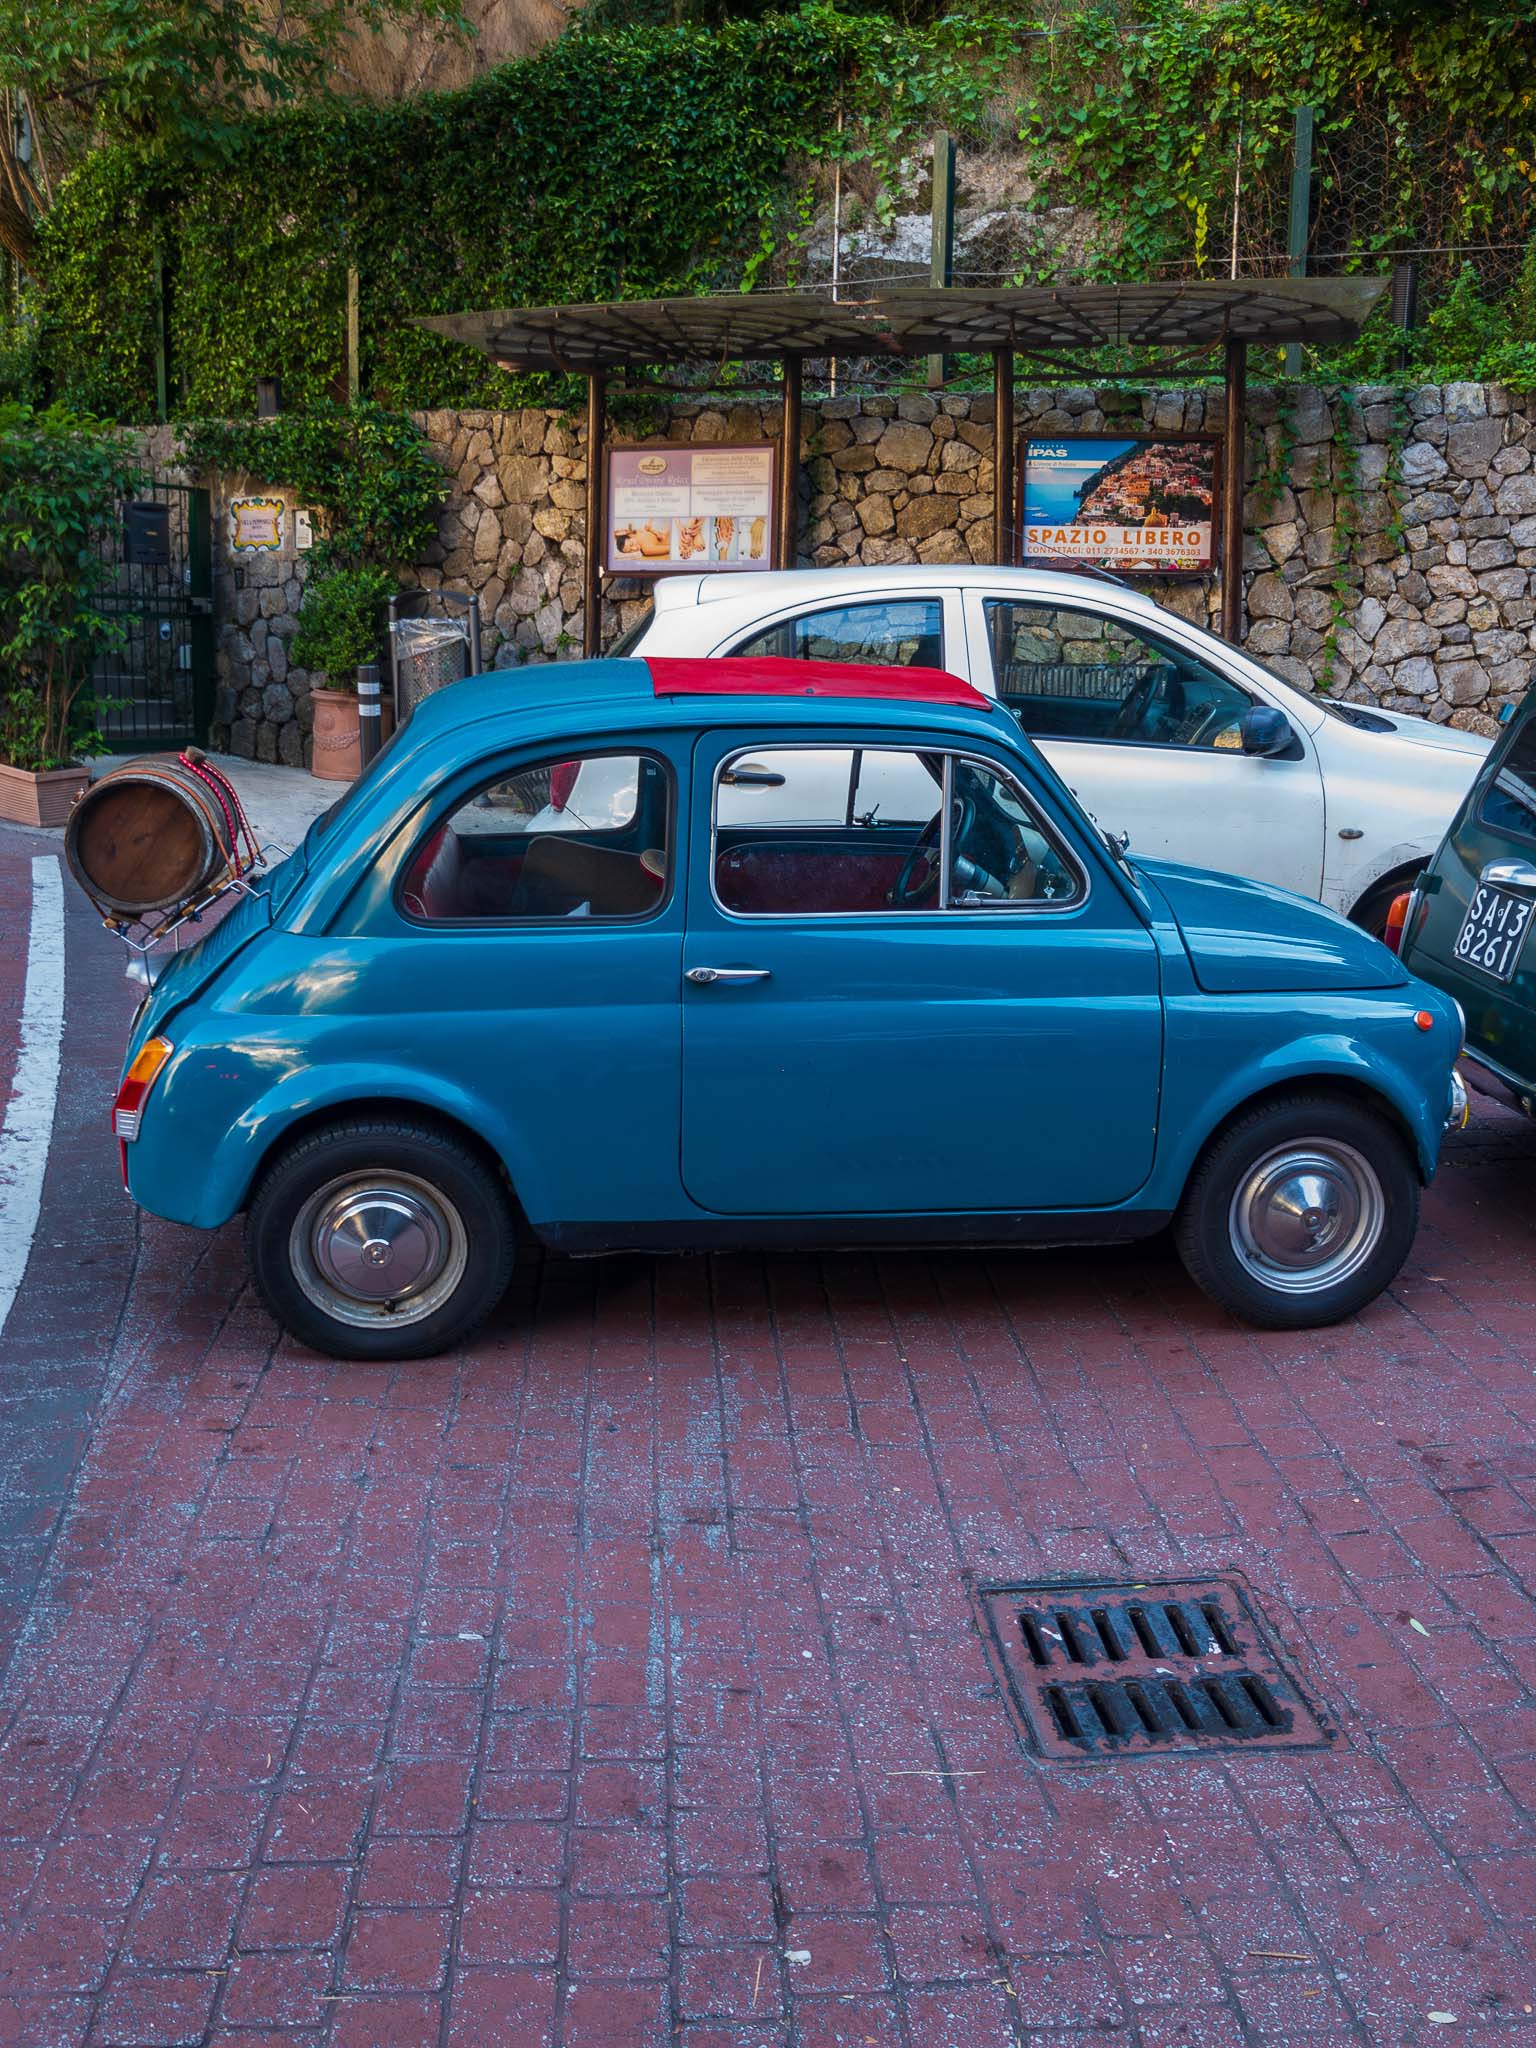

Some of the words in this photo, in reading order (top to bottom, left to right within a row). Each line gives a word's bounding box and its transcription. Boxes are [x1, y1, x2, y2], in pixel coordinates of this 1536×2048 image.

[1028, 528, 1107, 545] SPAZIO
[1123, 530, 1201, 546] LIBERO
[1459, 923, 1513, 973] 8261
